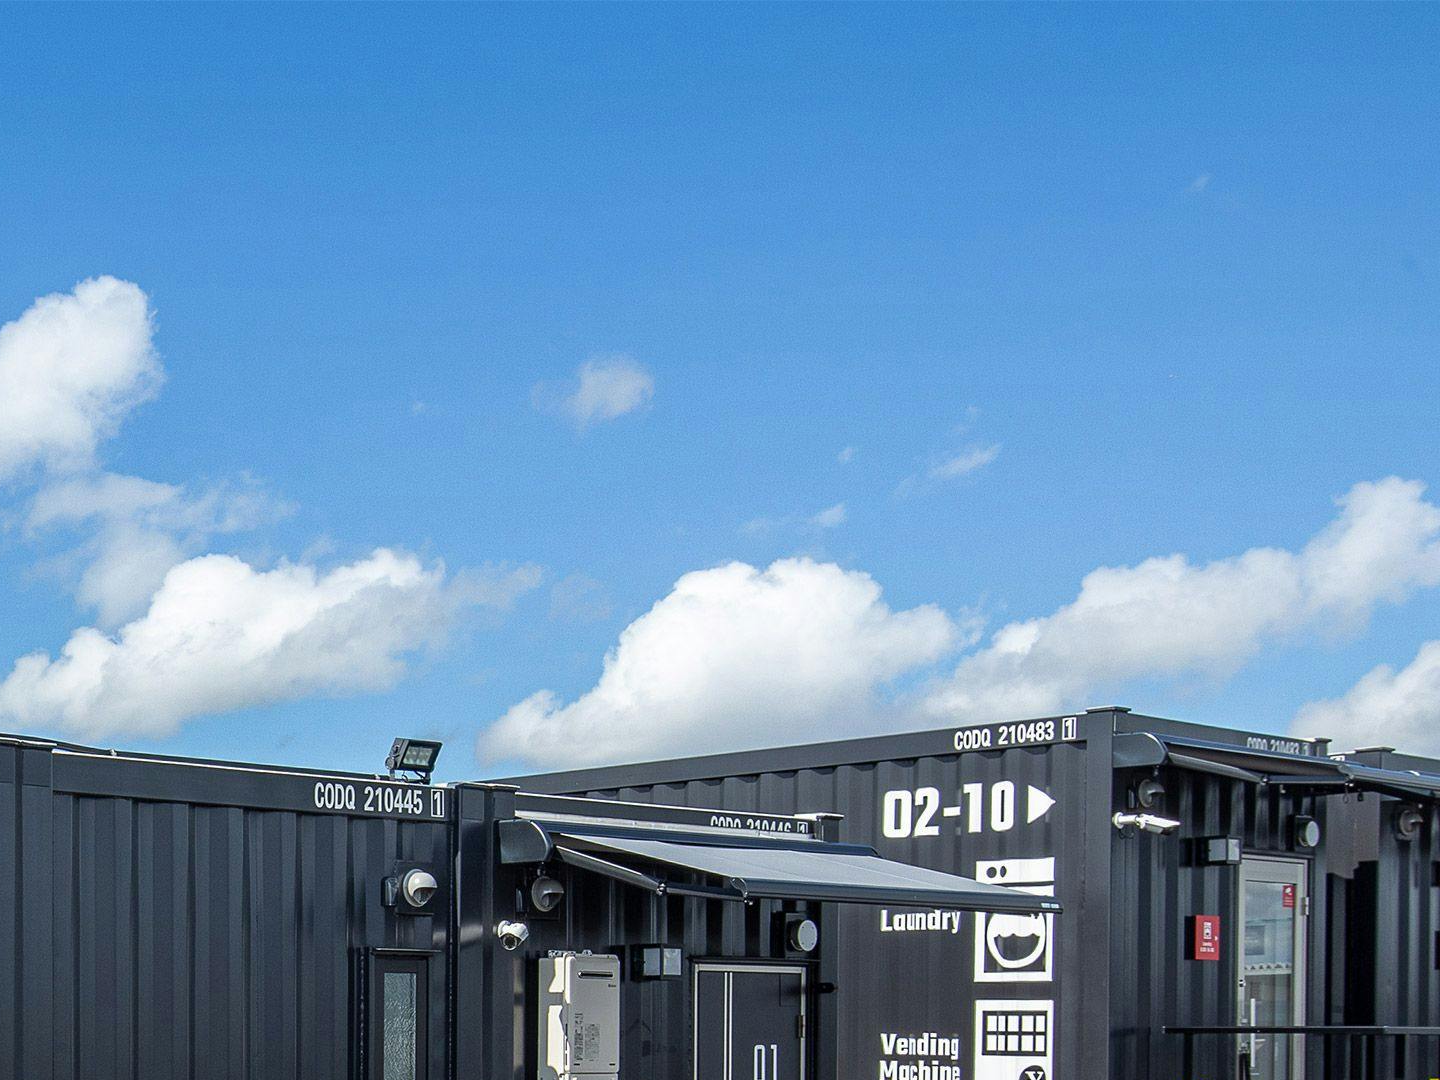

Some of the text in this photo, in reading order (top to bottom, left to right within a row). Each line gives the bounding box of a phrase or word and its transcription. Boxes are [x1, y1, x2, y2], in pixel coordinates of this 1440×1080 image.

[953, 728, 992, 750] CODQ
[998, 720, 1055, 745] 210483
[314, 782, 444, 816] CODQ 210445 1
[882, 780, 1015, 839] 02-10
[879, 909, 961, 934] Laundry
[879, 1032, 960, 1060] Vending
